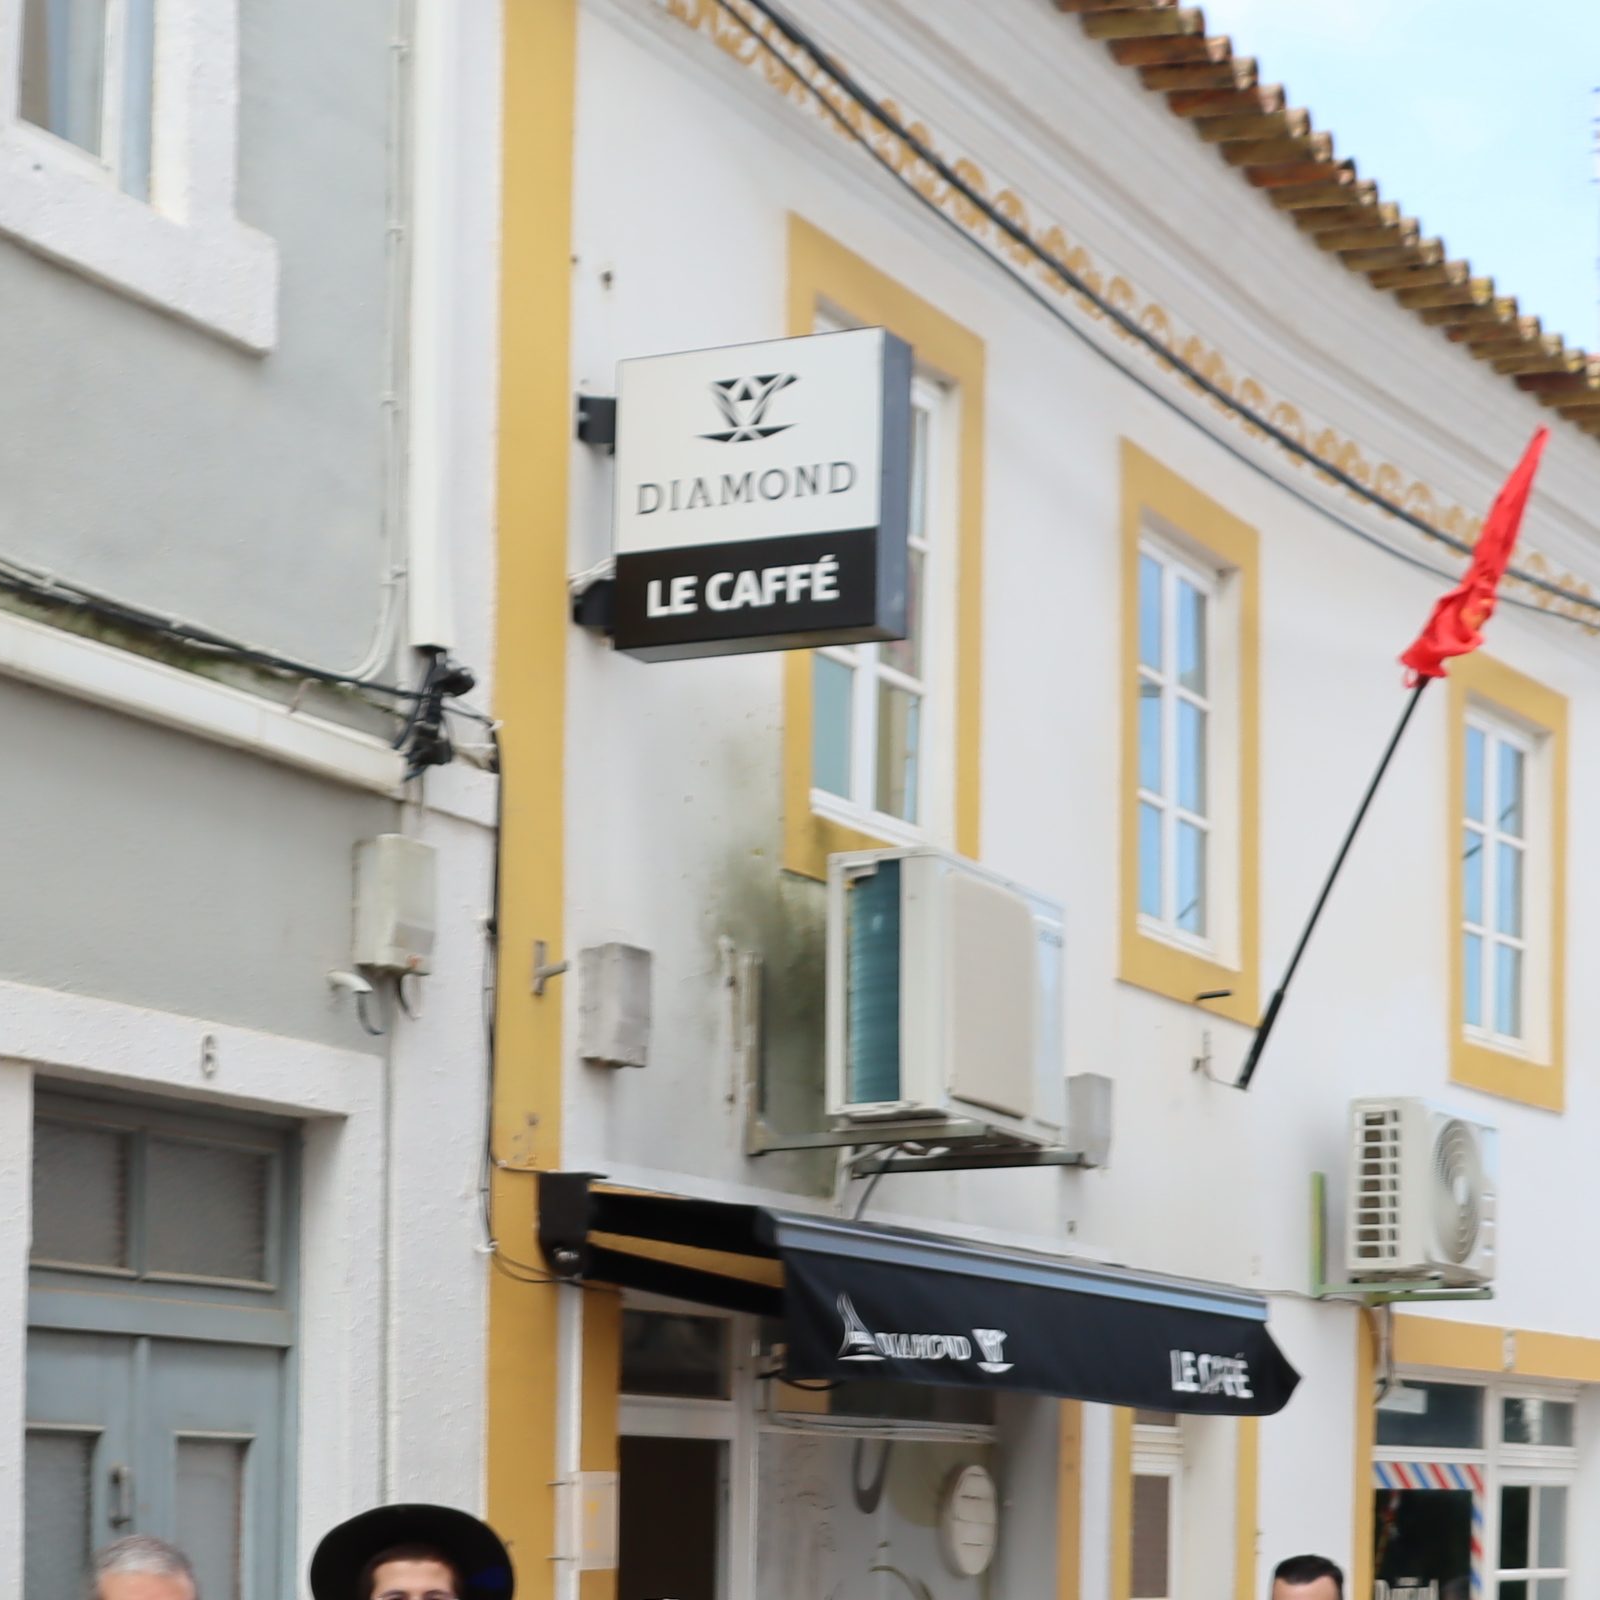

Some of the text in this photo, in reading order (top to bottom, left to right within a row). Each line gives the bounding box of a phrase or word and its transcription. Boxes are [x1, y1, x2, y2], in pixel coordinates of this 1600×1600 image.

[635, 460, 858, 516] DIAMOND
[645, 554, 840, 618] LE CAFFÉ
